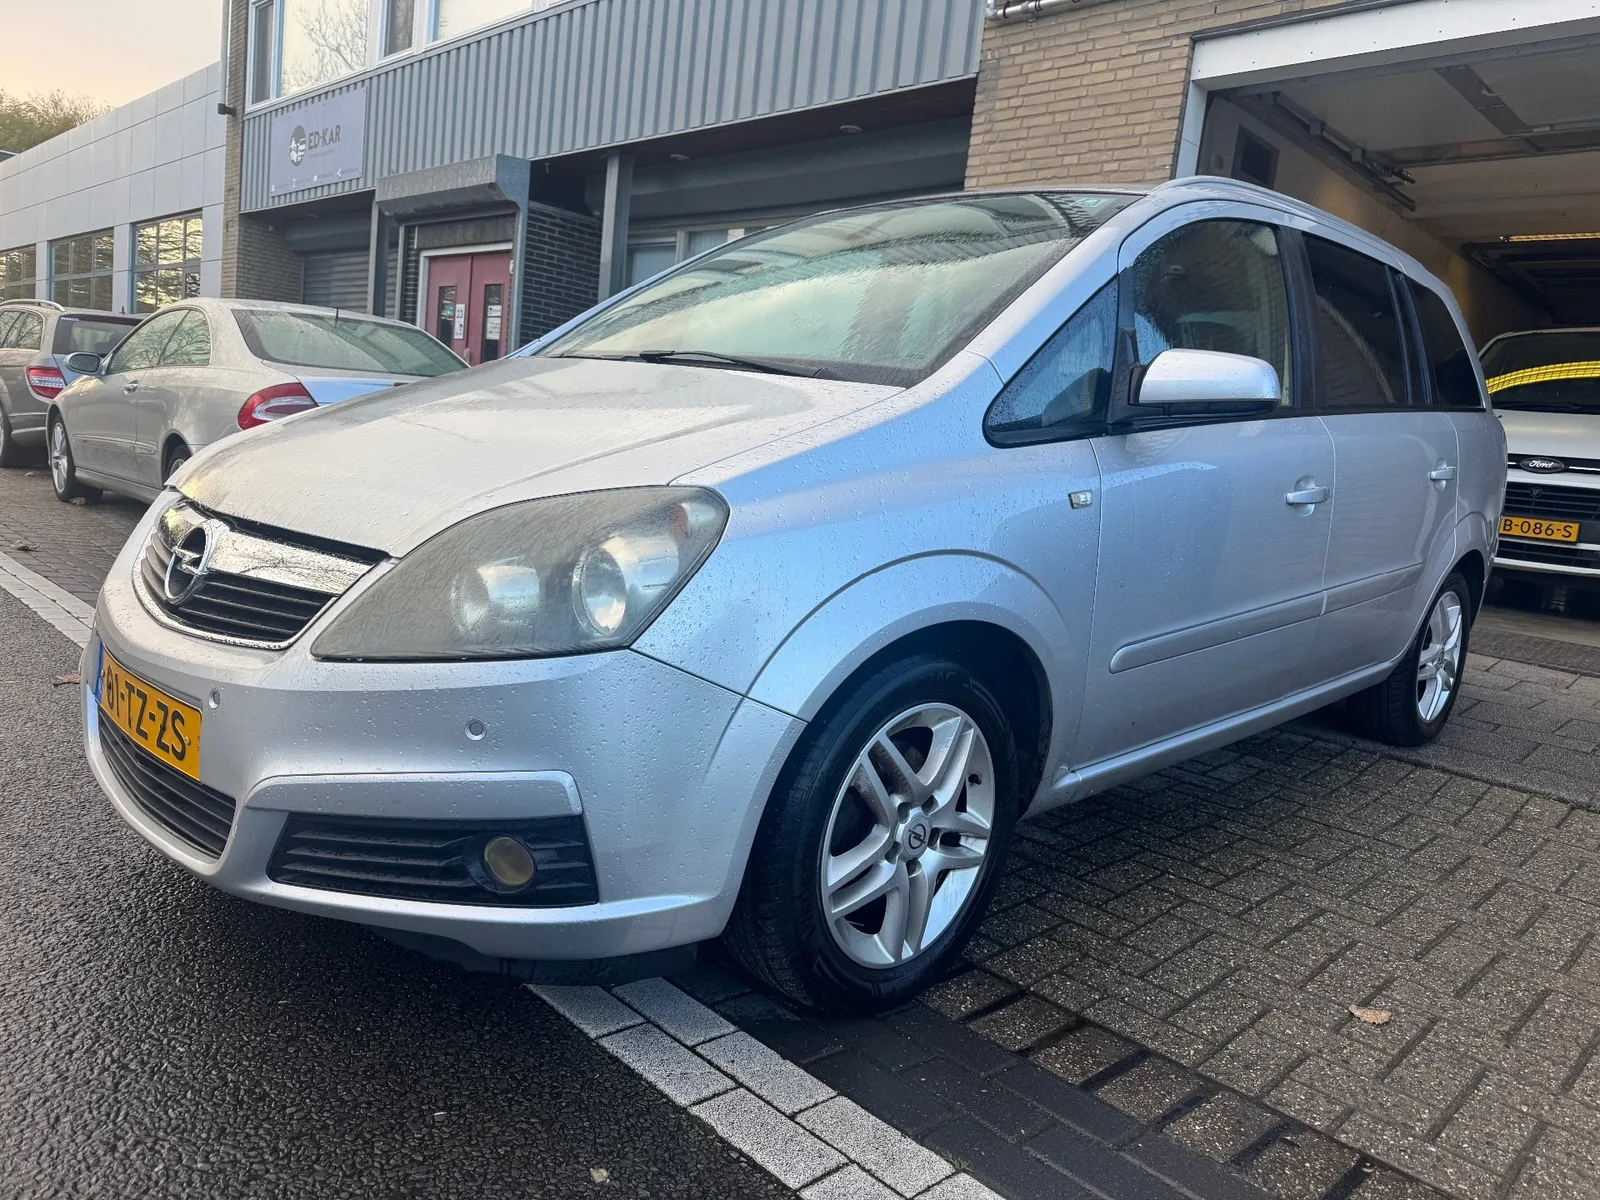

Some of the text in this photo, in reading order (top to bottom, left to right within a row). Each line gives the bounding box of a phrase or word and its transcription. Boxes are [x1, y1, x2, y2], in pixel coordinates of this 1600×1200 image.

[308, 124, 341, 150] ED-KAR
[1529, 460, 1555, 468] Ford
[1503, 519, 1573, 538] B-086-S
